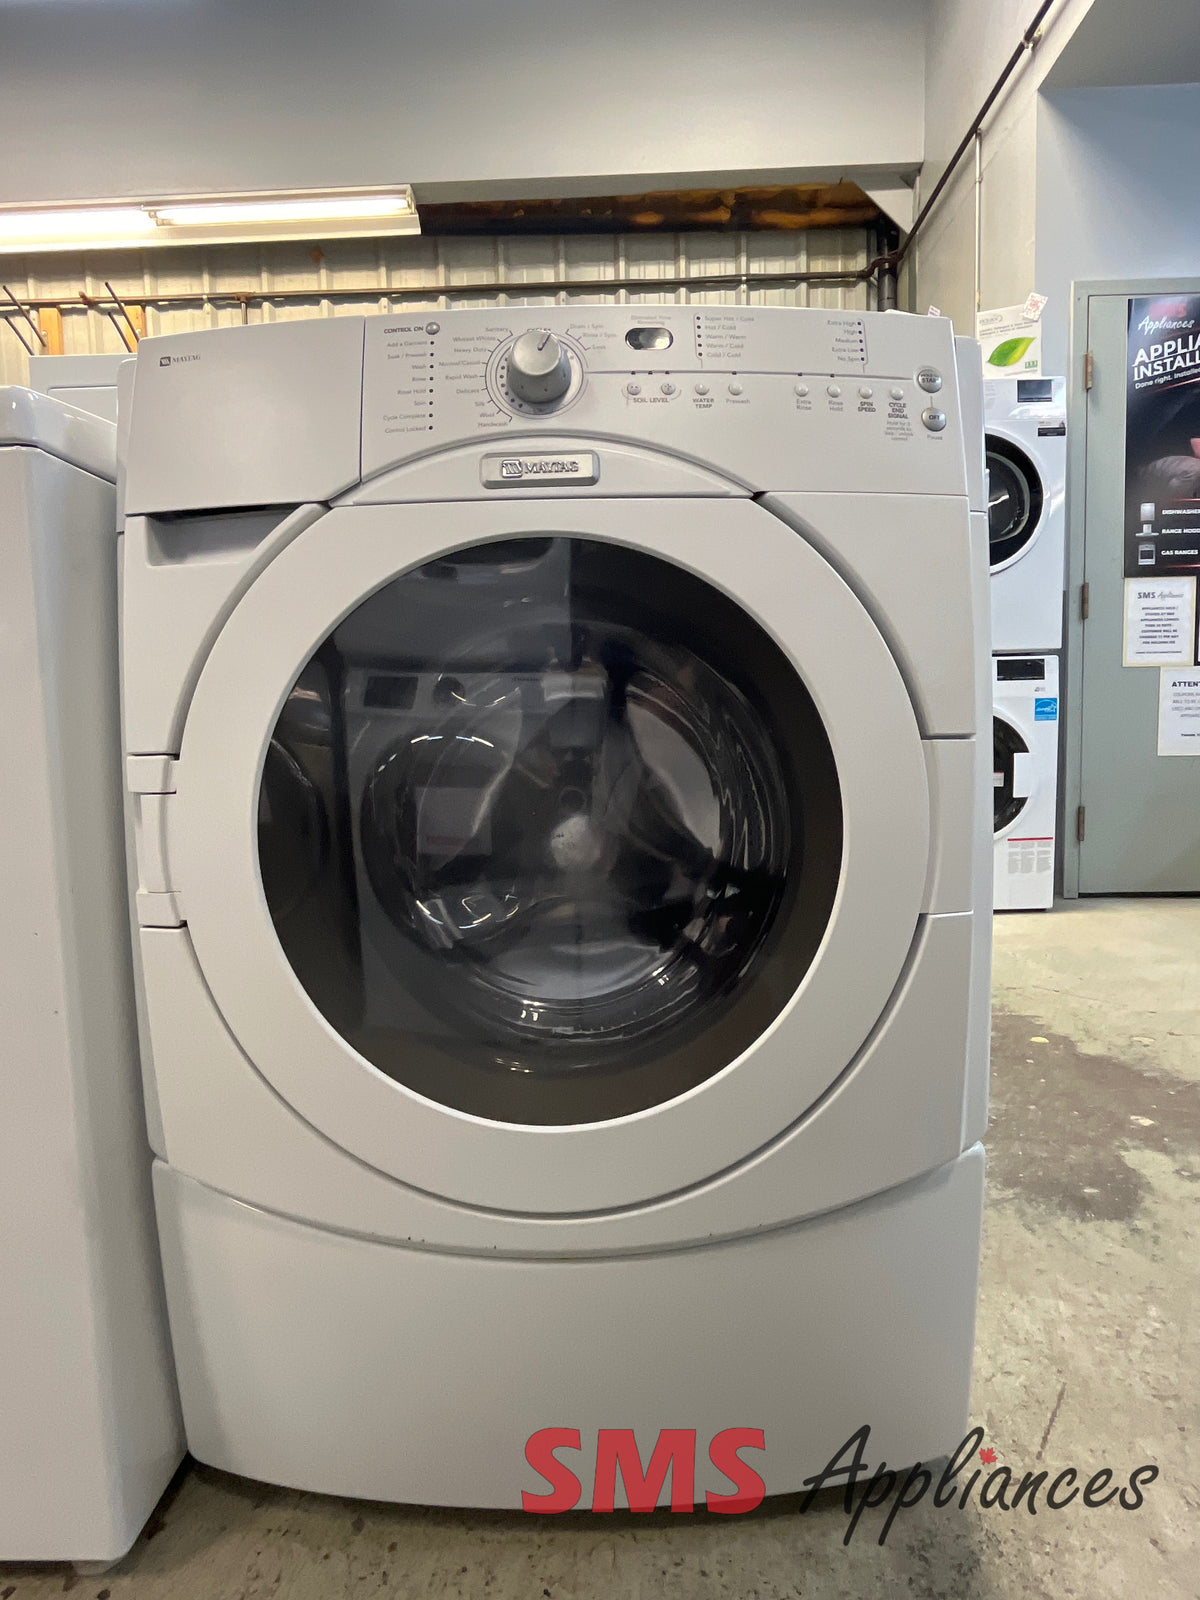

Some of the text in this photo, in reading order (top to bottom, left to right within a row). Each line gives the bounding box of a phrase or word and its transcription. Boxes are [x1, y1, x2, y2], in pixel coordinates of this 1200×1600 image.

[1138, 315, 1195, 336] Appliances
[173, 354, 200, 363] MAYTAG
[1135, 380, 1153, 389] Done
[524, 461, 579, 474] MAYTAG
